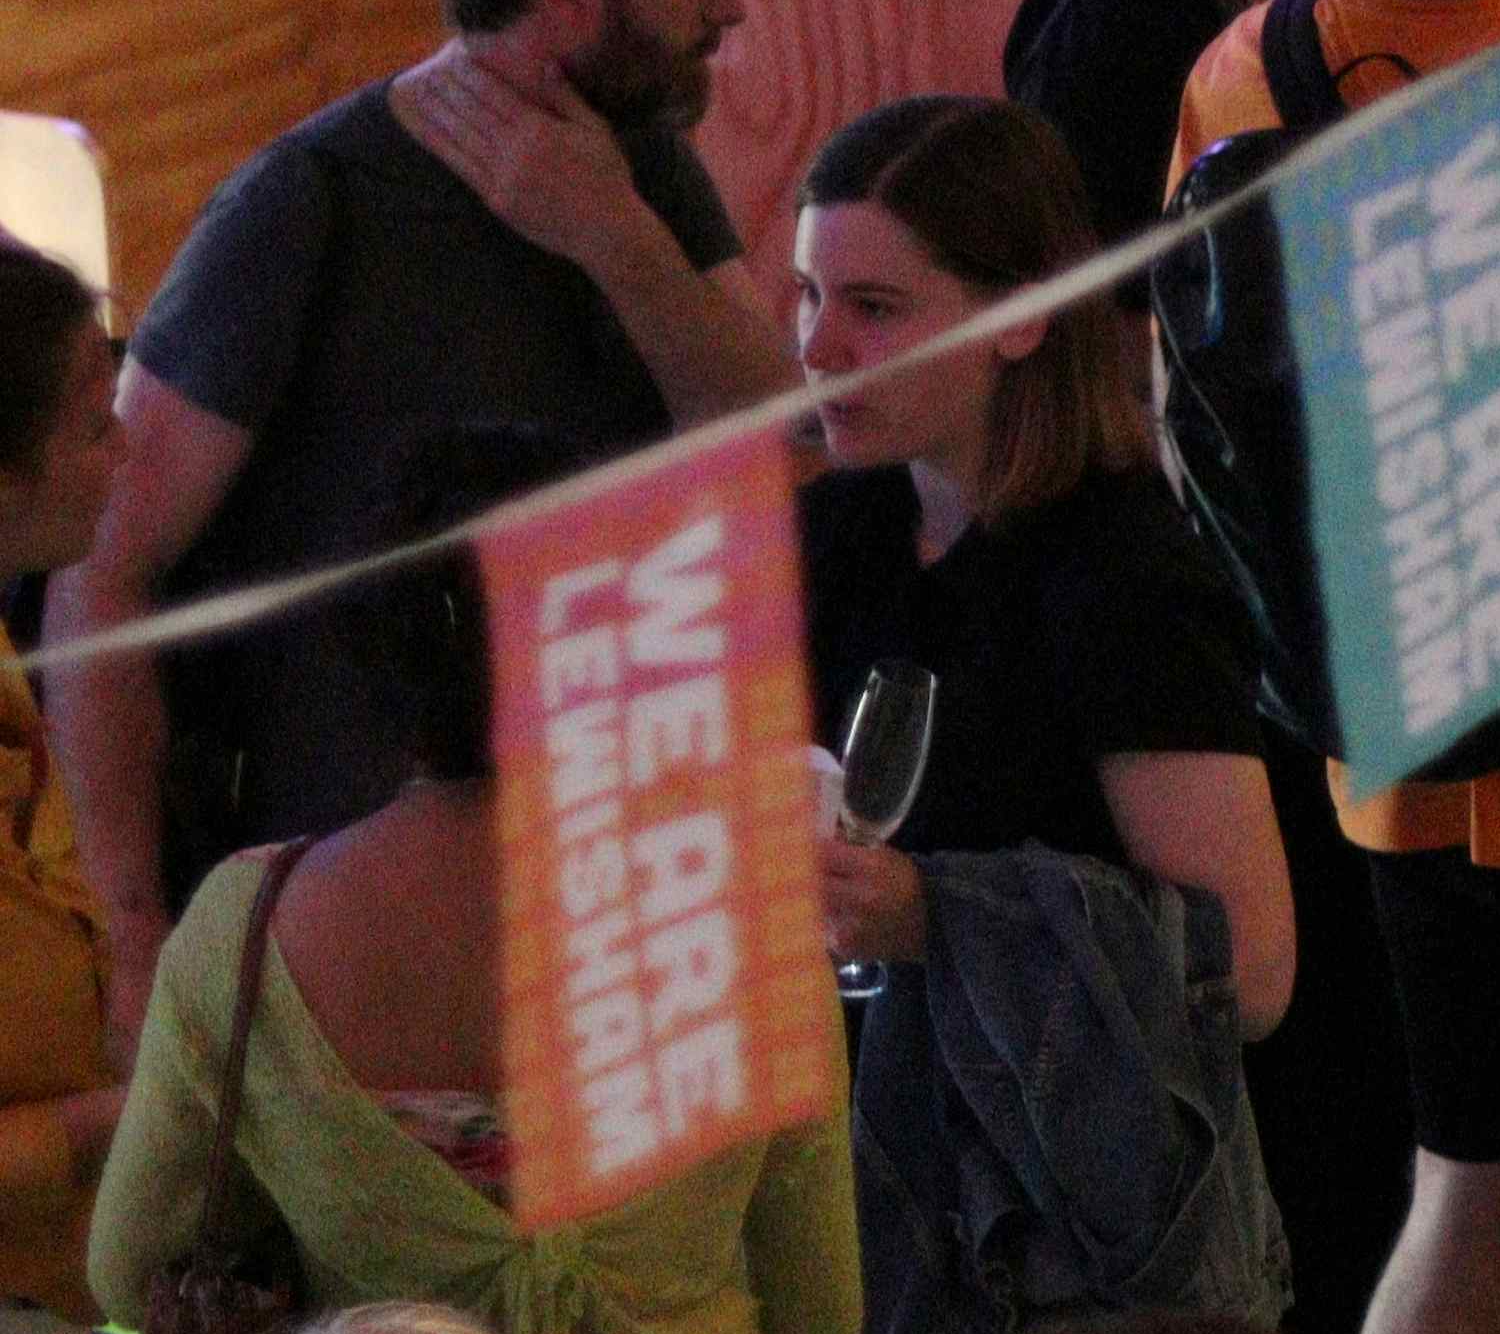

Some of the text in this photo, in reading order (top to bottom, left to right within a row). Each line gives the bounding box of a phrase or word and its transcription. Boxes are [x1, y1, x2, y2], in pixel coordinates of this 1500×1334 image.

[1348, 176, 1468, 736] LEWISHAM
[536, 561, 663, 1179] LEWISHAM
[624, 514, 749, 1140] WE ARE
